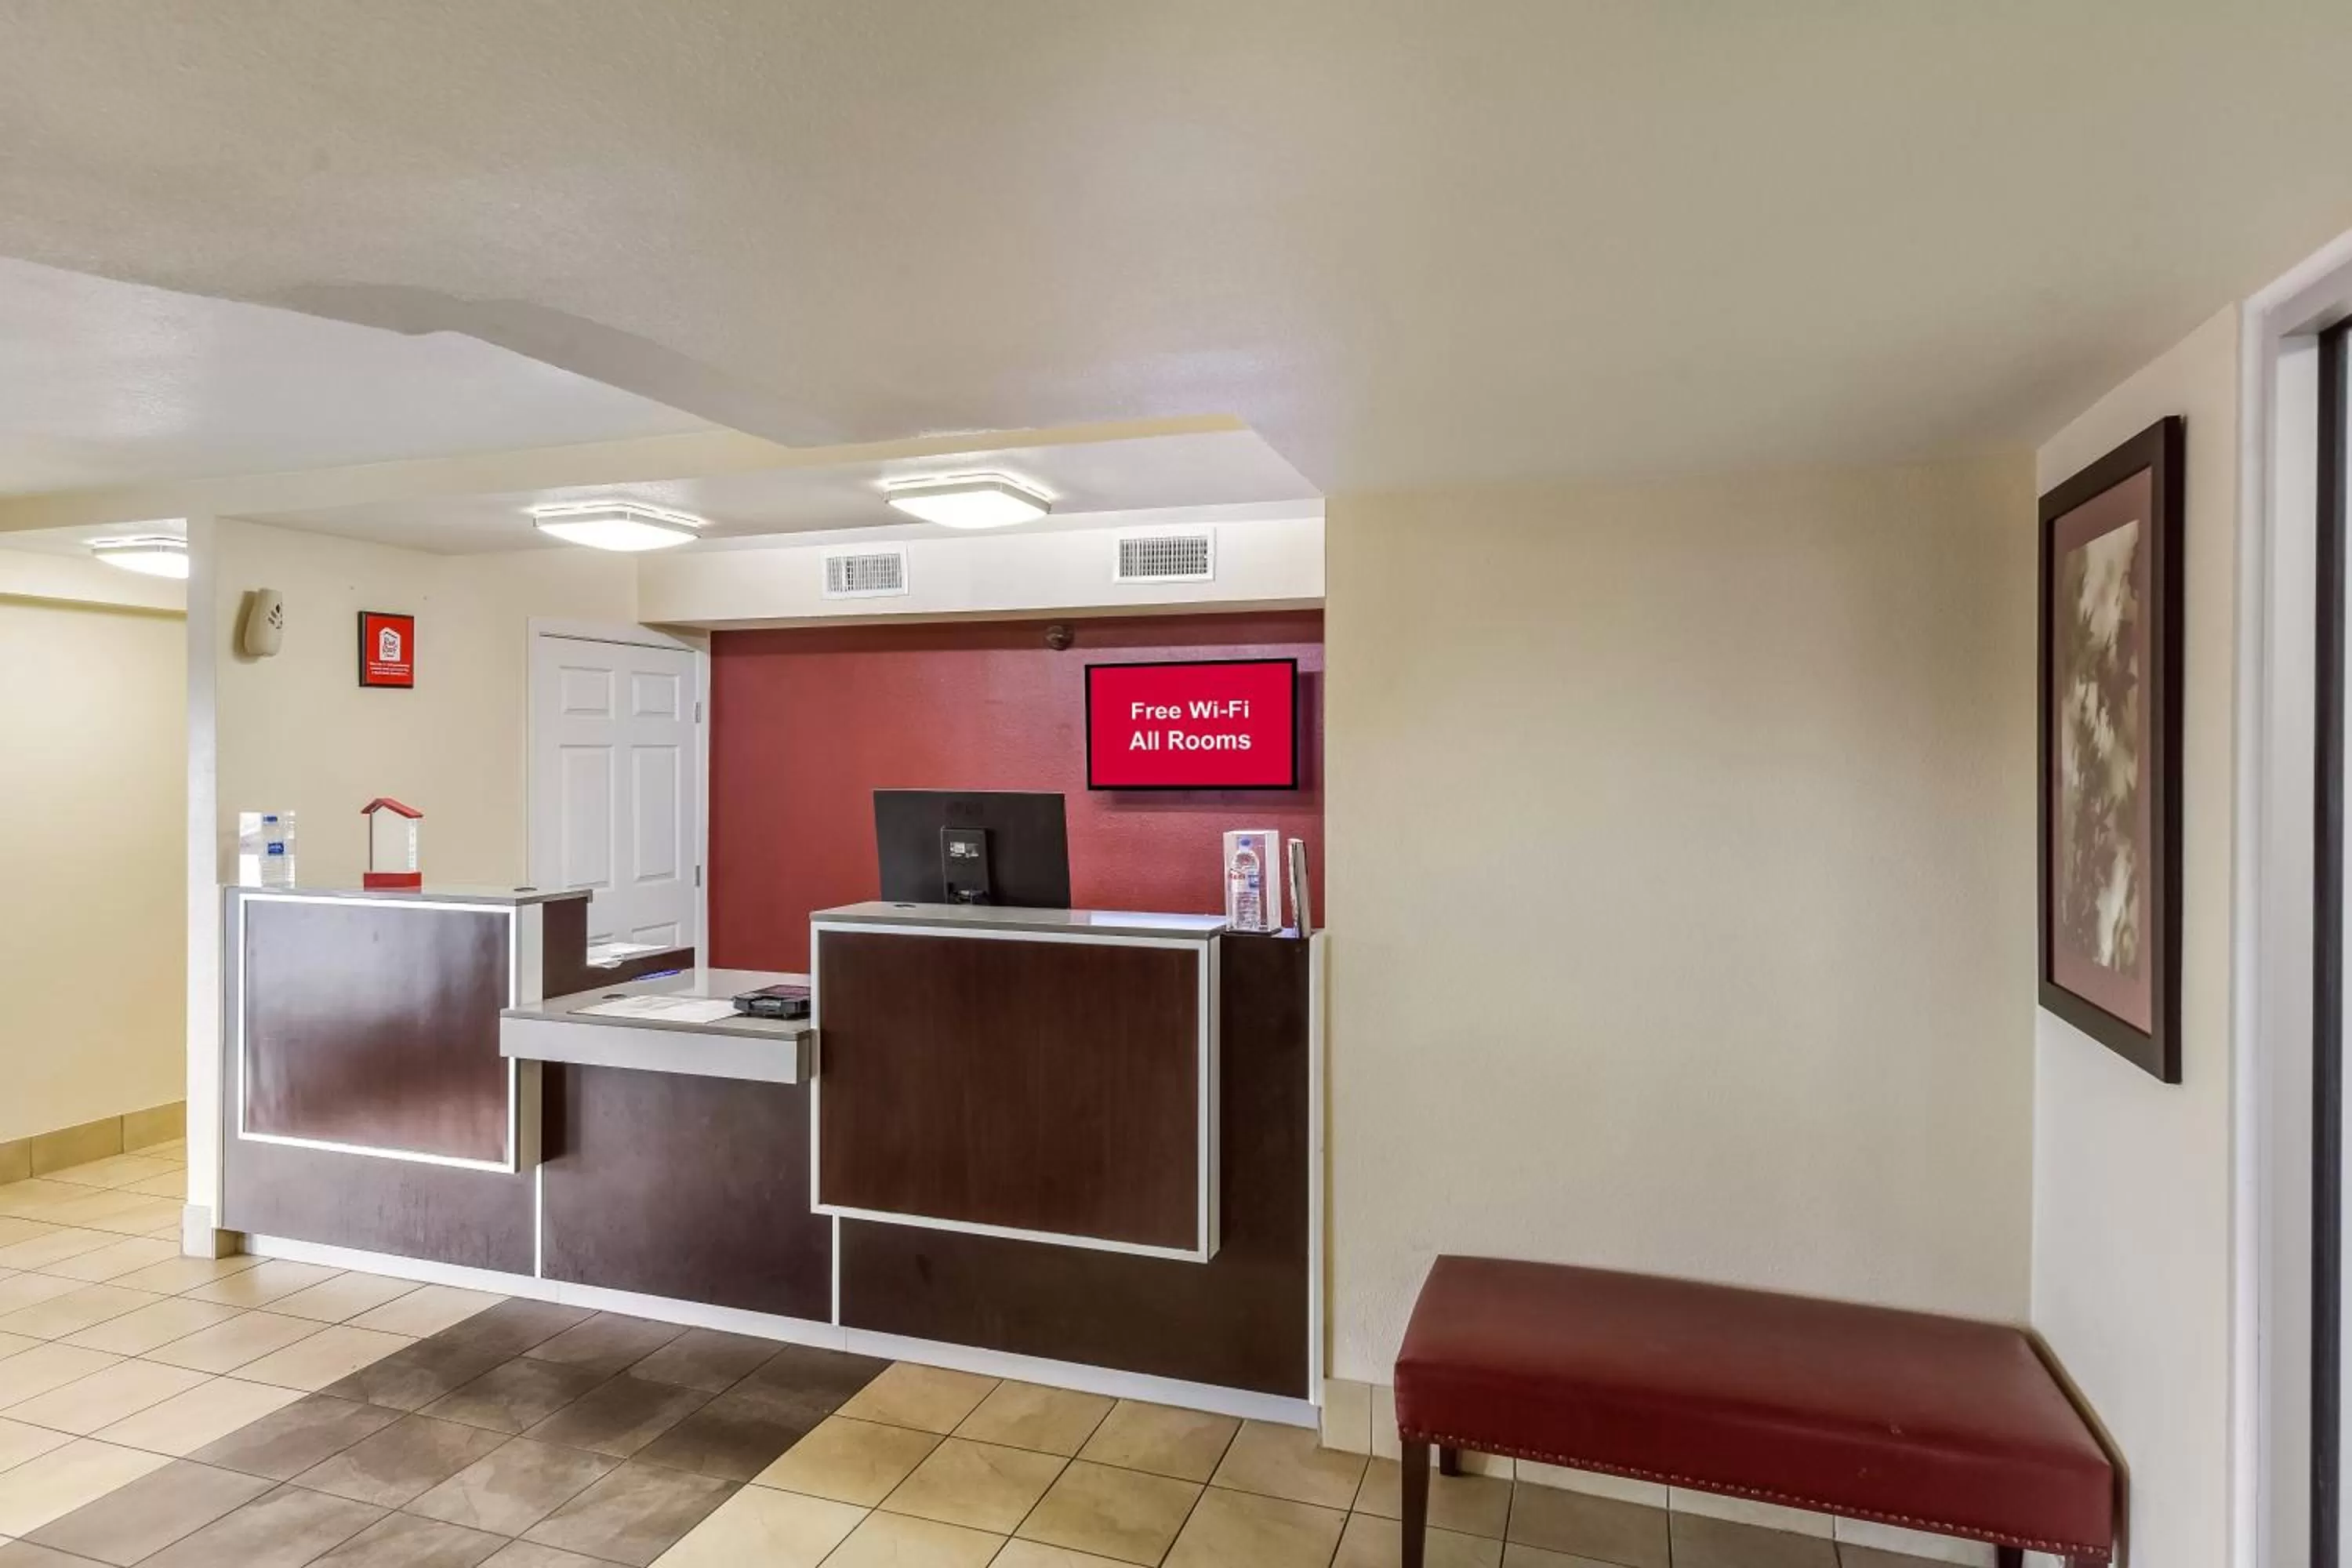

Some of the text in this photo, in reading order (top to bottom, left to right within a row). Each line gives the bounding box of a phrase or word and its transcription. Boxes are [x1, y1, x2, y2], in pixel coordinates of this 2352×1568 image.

[1131, 700, 1250, 720] Free Wi-Fi
[1129, 730, 1252, 750] All Rooms
